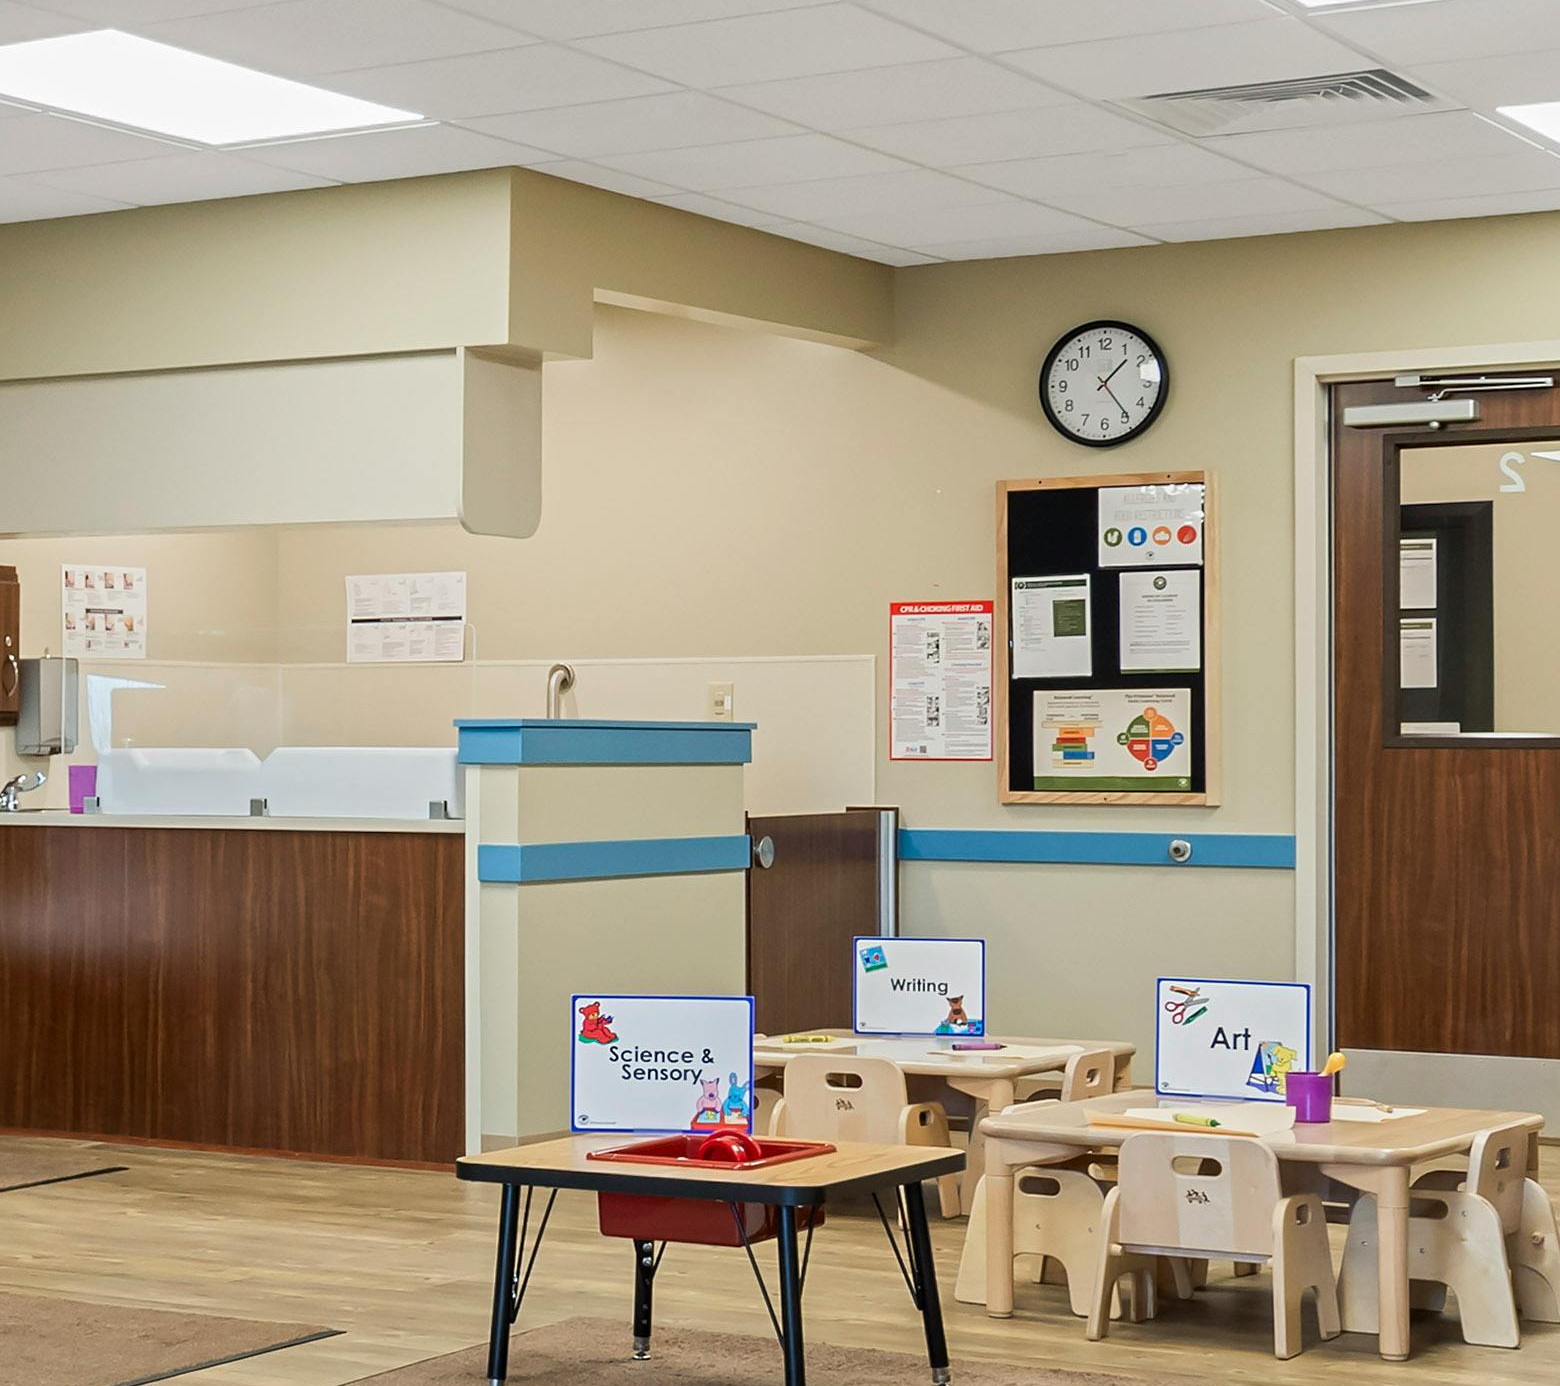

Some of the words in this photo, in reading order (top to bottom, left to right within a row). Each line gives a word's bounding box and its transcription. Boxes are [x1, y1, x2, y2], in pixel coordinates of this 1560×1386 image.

[1098, 337, 1112, 351] 12
[1121, 344, 1127, 355] 1
[1078, 346, 1091, 358] 11
[1064, 359, 1079, 371] 10
[1136, 355, 1146, 368] 2
[1059, 380, 1068, 393] 9
[1064, 399, 1074, 412] 8
[1136, 396, 1144, 408] 4
[1081, 413, 1090, 426] 7
[1100, 418, 1109, 430] 6
[1121, 412, 1130, 424] 5
[890, 978, 948, 996] Writing
[1210, 1026, 1251, 1050] Art
[609, 1045, 694, 1064] Science
[701, 1048, 715, 1064] &
[621, 1064, 703, 1085] Sensory
